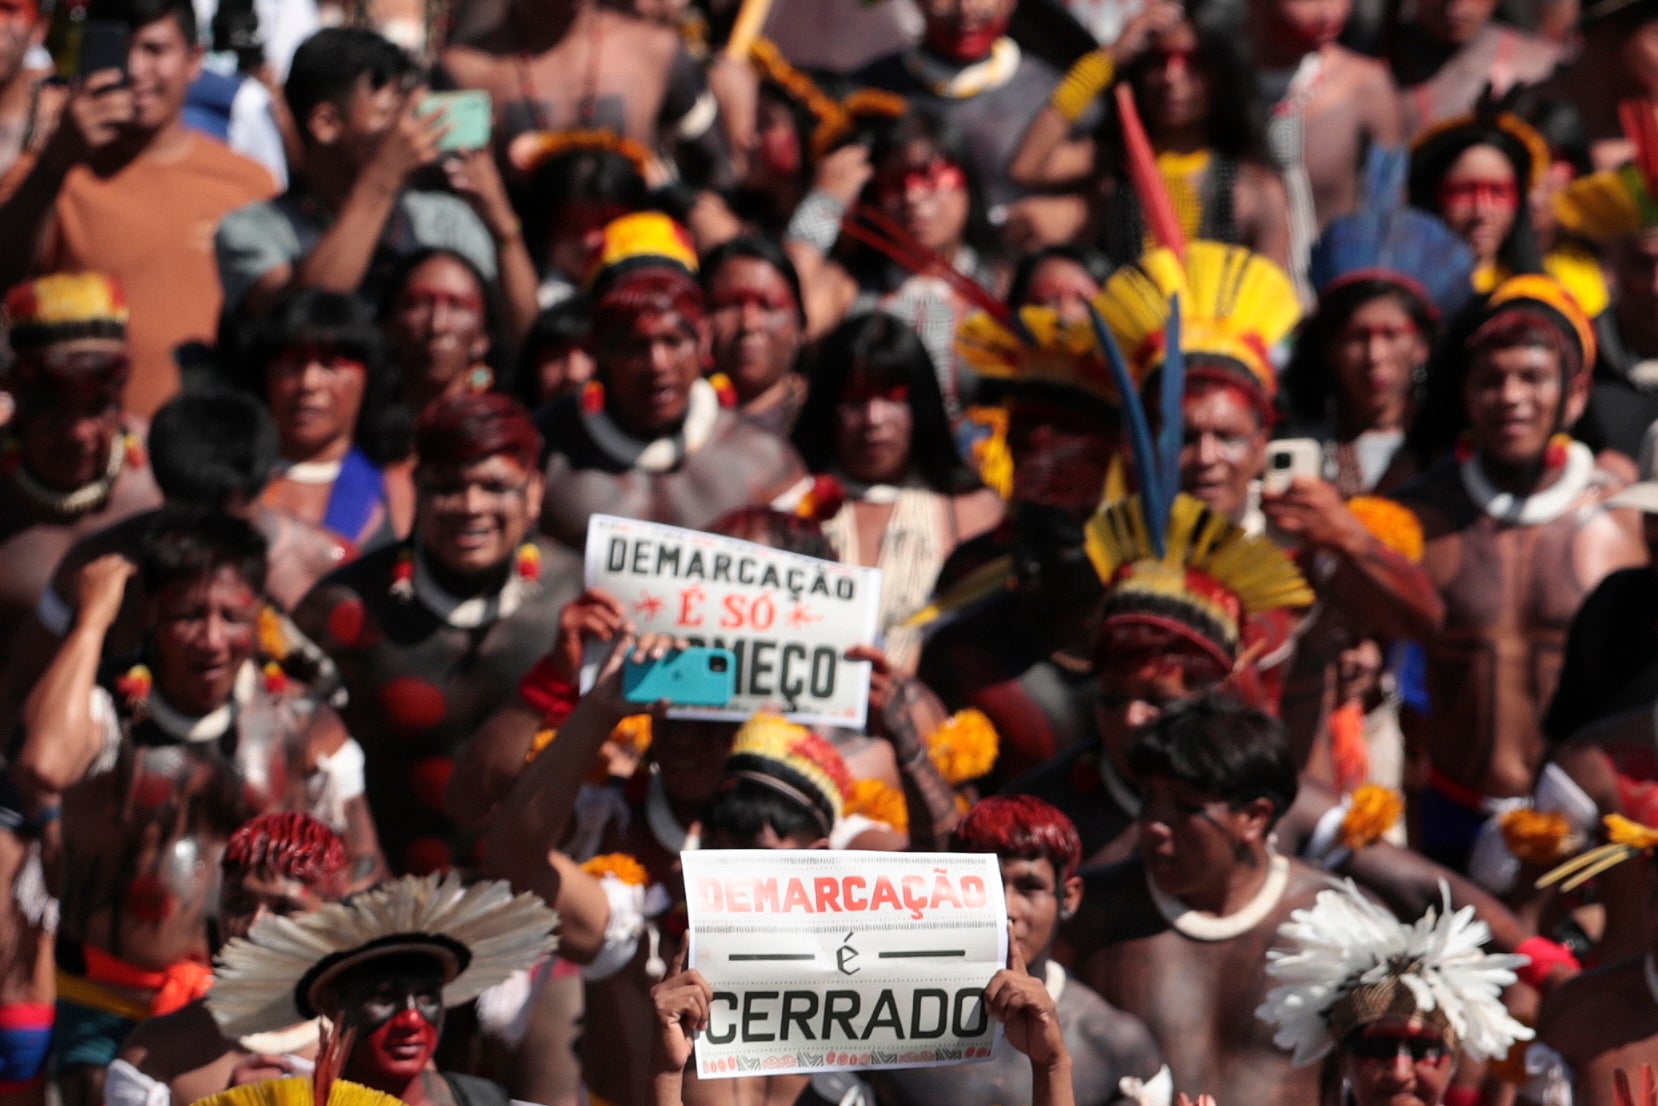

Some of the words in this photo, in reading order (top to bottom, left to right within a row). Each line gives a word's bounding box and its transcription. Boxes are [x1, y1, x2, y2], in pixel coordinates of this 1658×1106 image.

[607, 537, 855, 602] DEMARCAÇÃO
[676, 583, 706, 627] É
[721, 590, 777, 631] SÓ
[700, 867, 988, 920] DEMARCAÇÃO
[705, 986, 990, 1045] CERRADO
